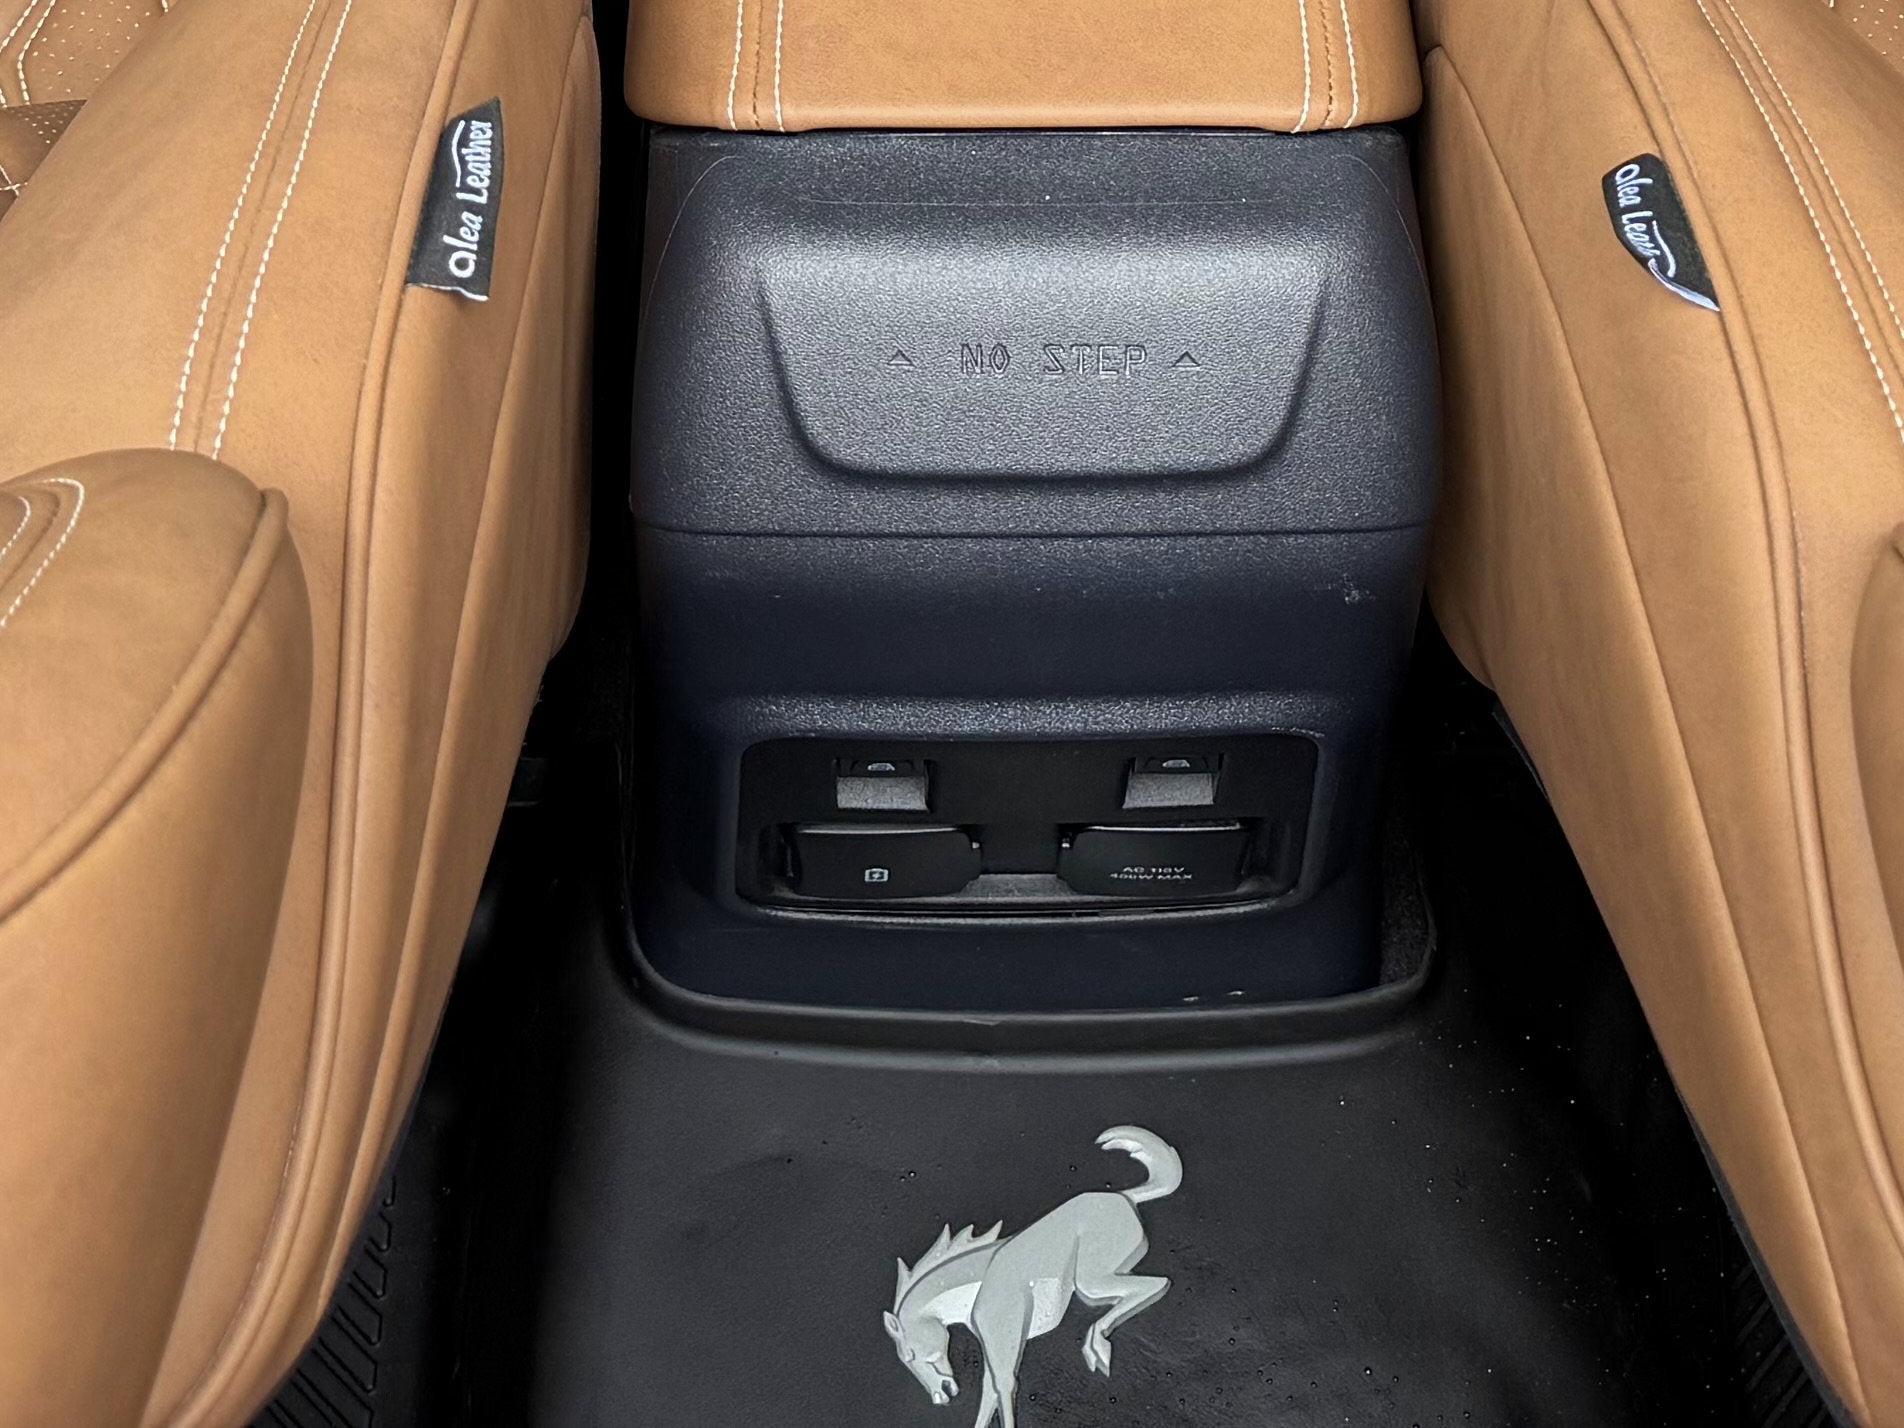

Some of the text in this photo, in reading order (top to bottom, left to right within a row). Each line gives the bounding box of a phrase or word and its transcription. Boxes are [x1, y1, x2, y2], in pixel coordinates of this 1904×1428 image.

[456, 120, 494, 205] Leather
[959, 343, 1148, 376] NO STEP
